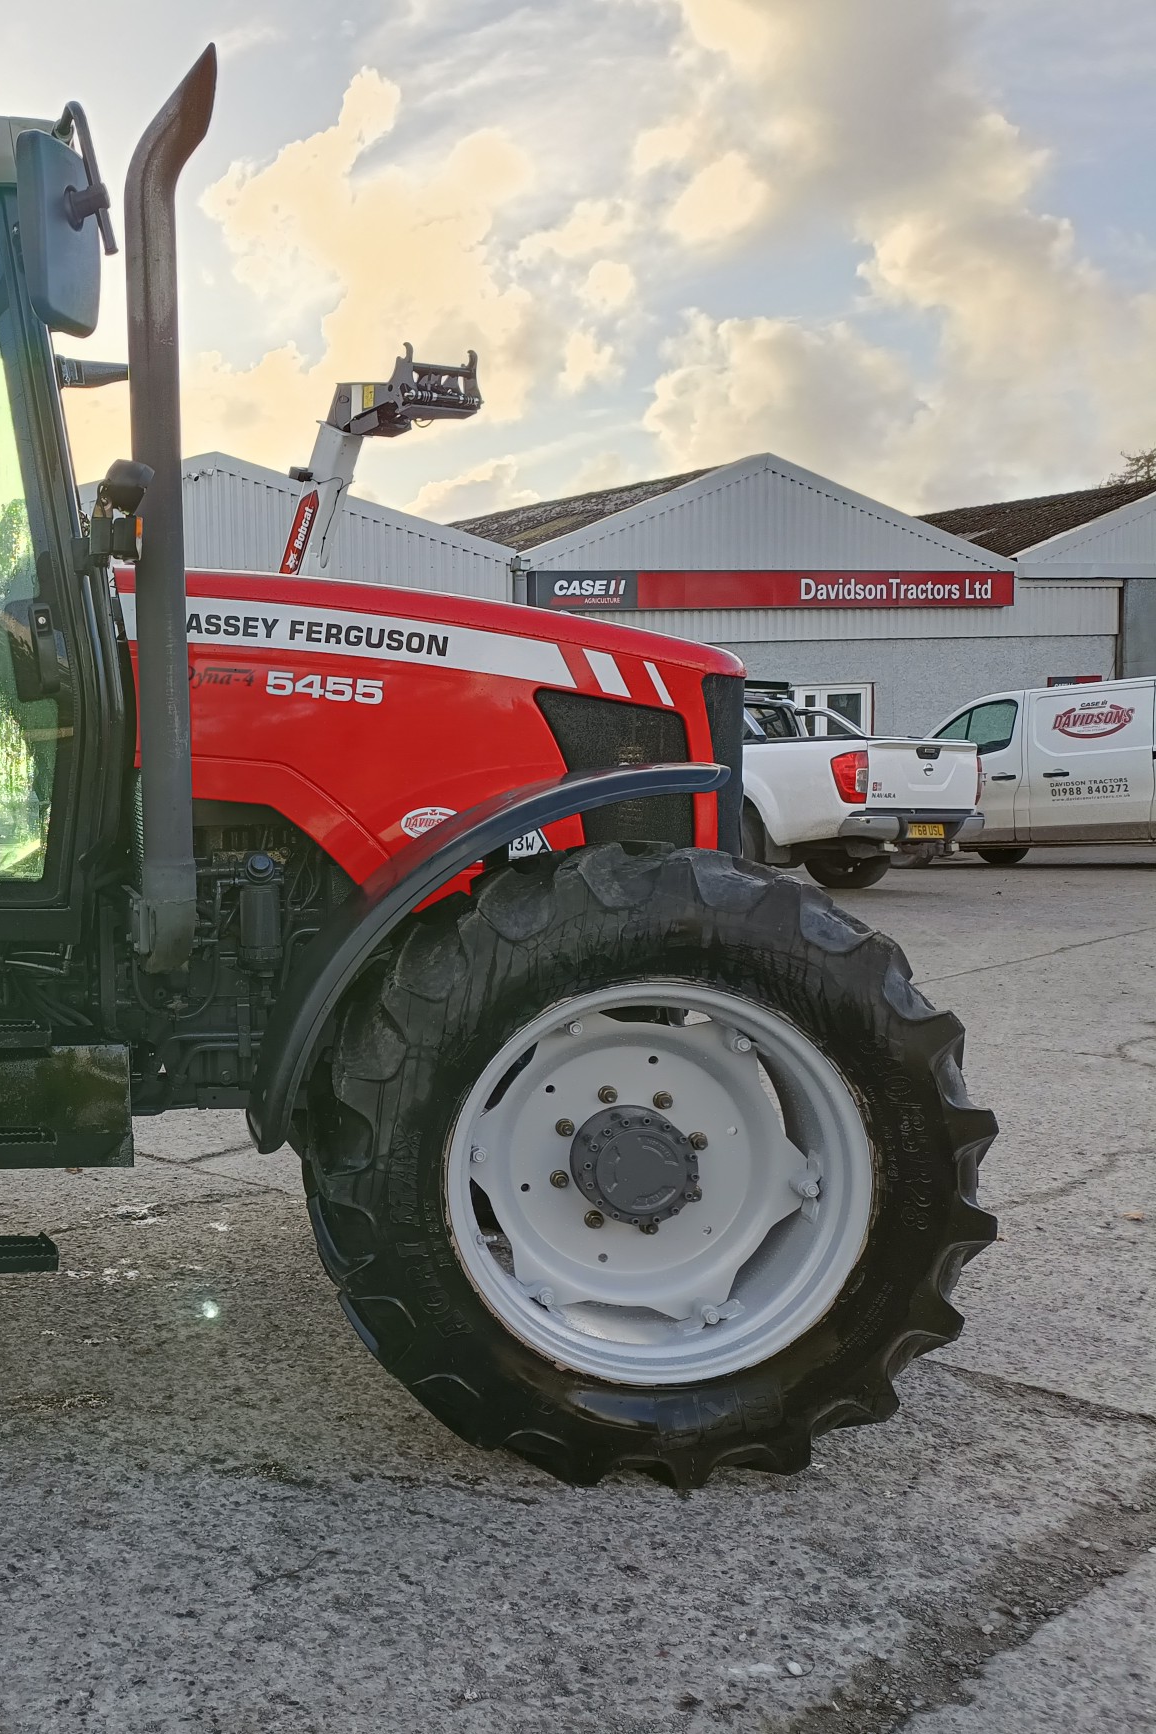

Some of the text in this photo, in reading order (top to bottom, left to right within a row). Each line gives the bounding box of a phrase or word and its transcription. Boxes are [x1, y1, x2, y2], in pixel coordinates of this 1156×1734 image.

[294, 506, 314, 550] Bobcat
[554, 579, 608, 596] CASE
[800, 578, 992, 600] Davidson Tractors Ltd
[186, 613, 449, 657] ASSEY FERGUSON
[265, 670, 384, 705] 5455
[1052, 707, 1136, 731] DAVIDSONS
[1049, 777, 1128, 788] DAVIDSON TRACTORS
[1051, 783, 1130, 797] 01988 840272
[404, 817, 442, 829] DAVIDS
[928, 825, 943, 836] USL
